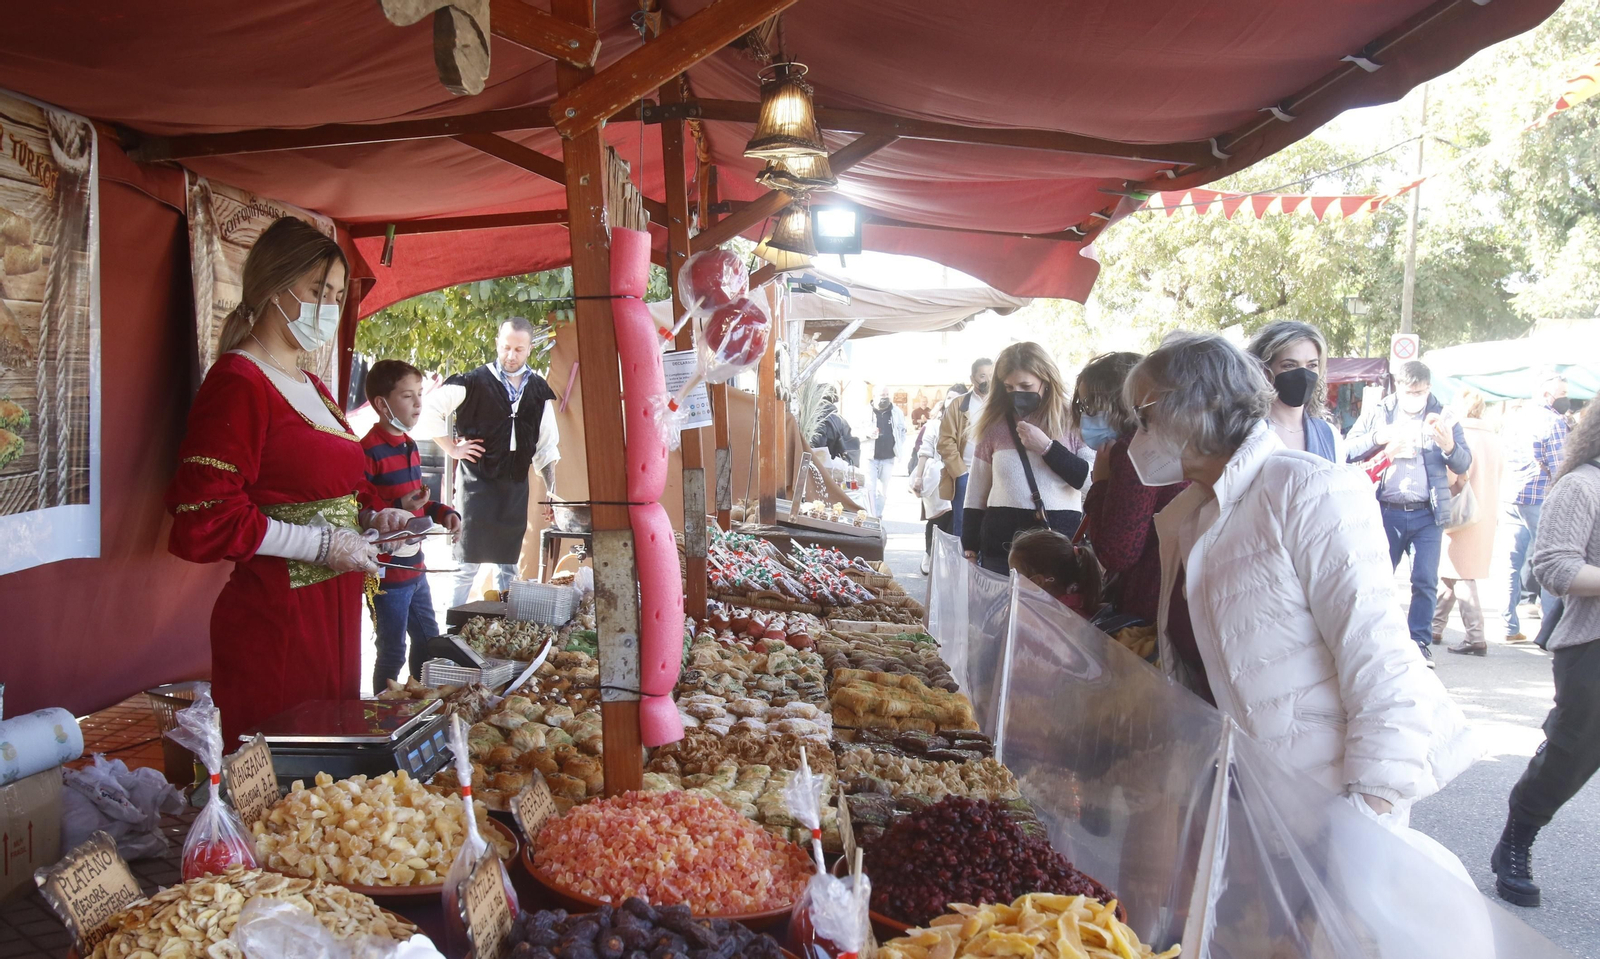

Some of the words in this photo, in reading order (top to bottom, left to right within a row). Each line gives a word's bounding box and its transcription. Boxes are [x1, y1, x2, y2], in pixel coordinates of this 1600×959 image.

[9, 133, 59, 200] TURKOS
[230, 746, 269, 790] MANZANA
[520, 783, 549, 824] PAPAYA
[57, 850, 113, 902] PLATANO
[468, 866, 496, 914] DATILES
[72, 883, 110, 918] MEJORA
[81, 883, 135, 933] COLESTEROL
[85, 922, 110, 950] REDU
